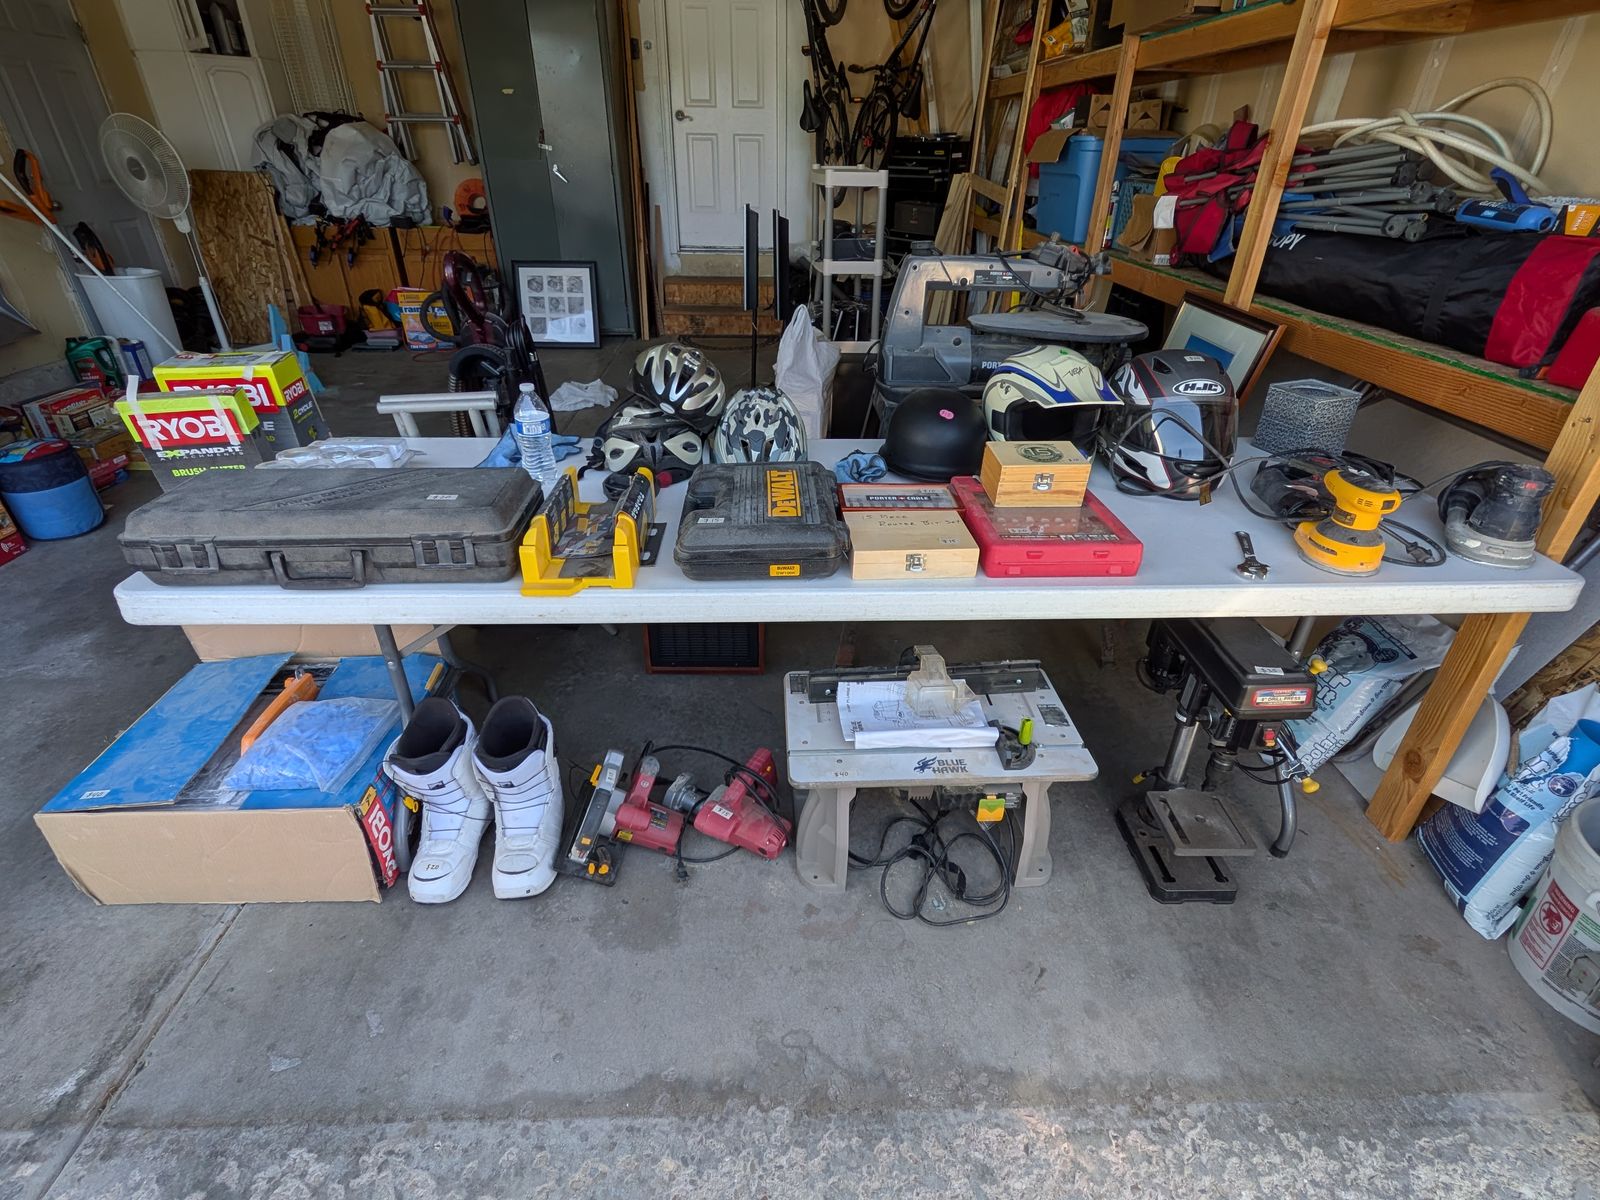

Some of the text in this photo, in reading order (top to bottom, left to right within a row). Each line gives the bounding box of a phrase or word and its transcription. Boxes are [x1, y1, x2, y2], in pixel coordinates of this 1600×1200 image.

[981, 361, 1002, 370] PORT
[284, 380, 305, 402] RYOBI
[1182, 383, 1219, 392] HJC
[138, 415, 238, 443] RYOBI
[156, 446, 242, 458] EXPAND-IT
[771, 470, 798, 517] DEWALT
[1301, 731, 1339, 769] Polar
[937, 758, 967, 767] BLUE
[931, 766, 969, 775] HAWK
